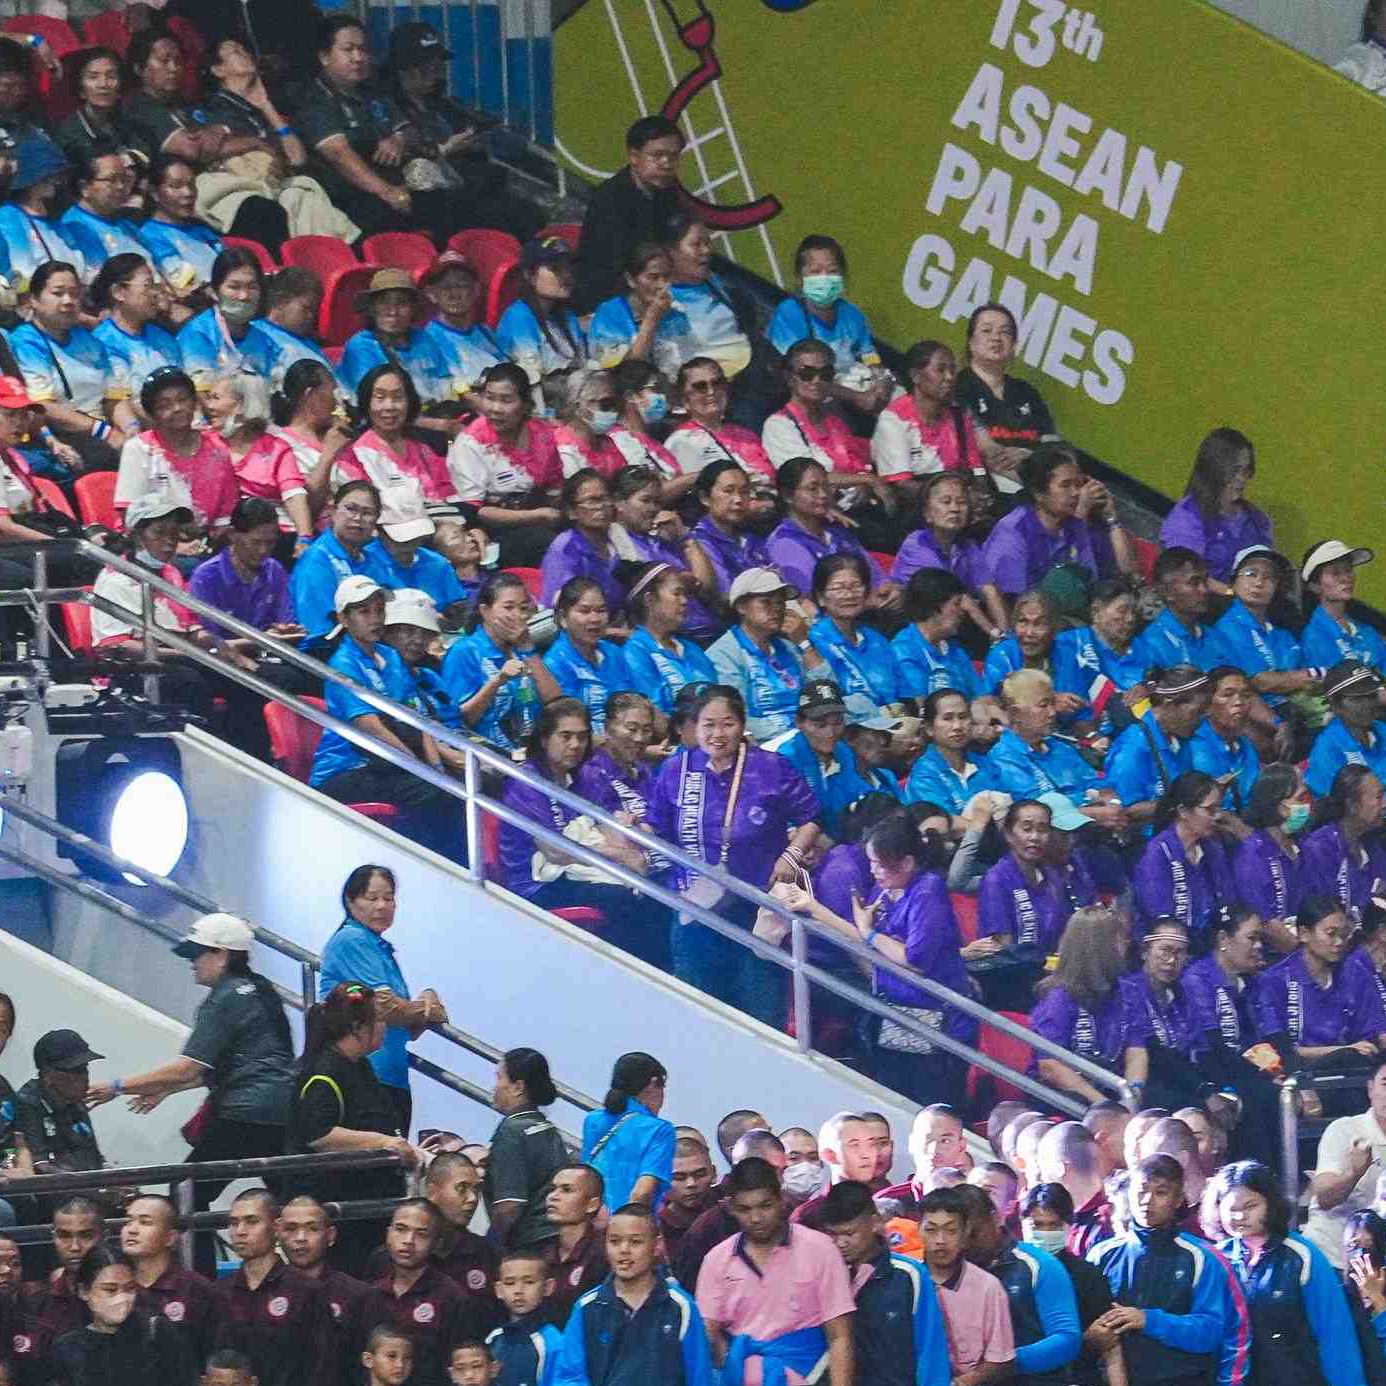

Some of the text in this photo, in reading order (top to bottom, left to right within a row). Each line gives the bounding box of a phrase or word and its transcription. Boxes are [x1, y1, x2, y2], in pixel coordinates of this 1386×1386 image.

[990, 0, 1104, 68] 13th
[924, 142, 1100, 296] PARA
[950, 62, 1184, 234] ASEAN
[902, 233, 1135, 405] GAMES
[680, 804, 702, 842] HEALTH
